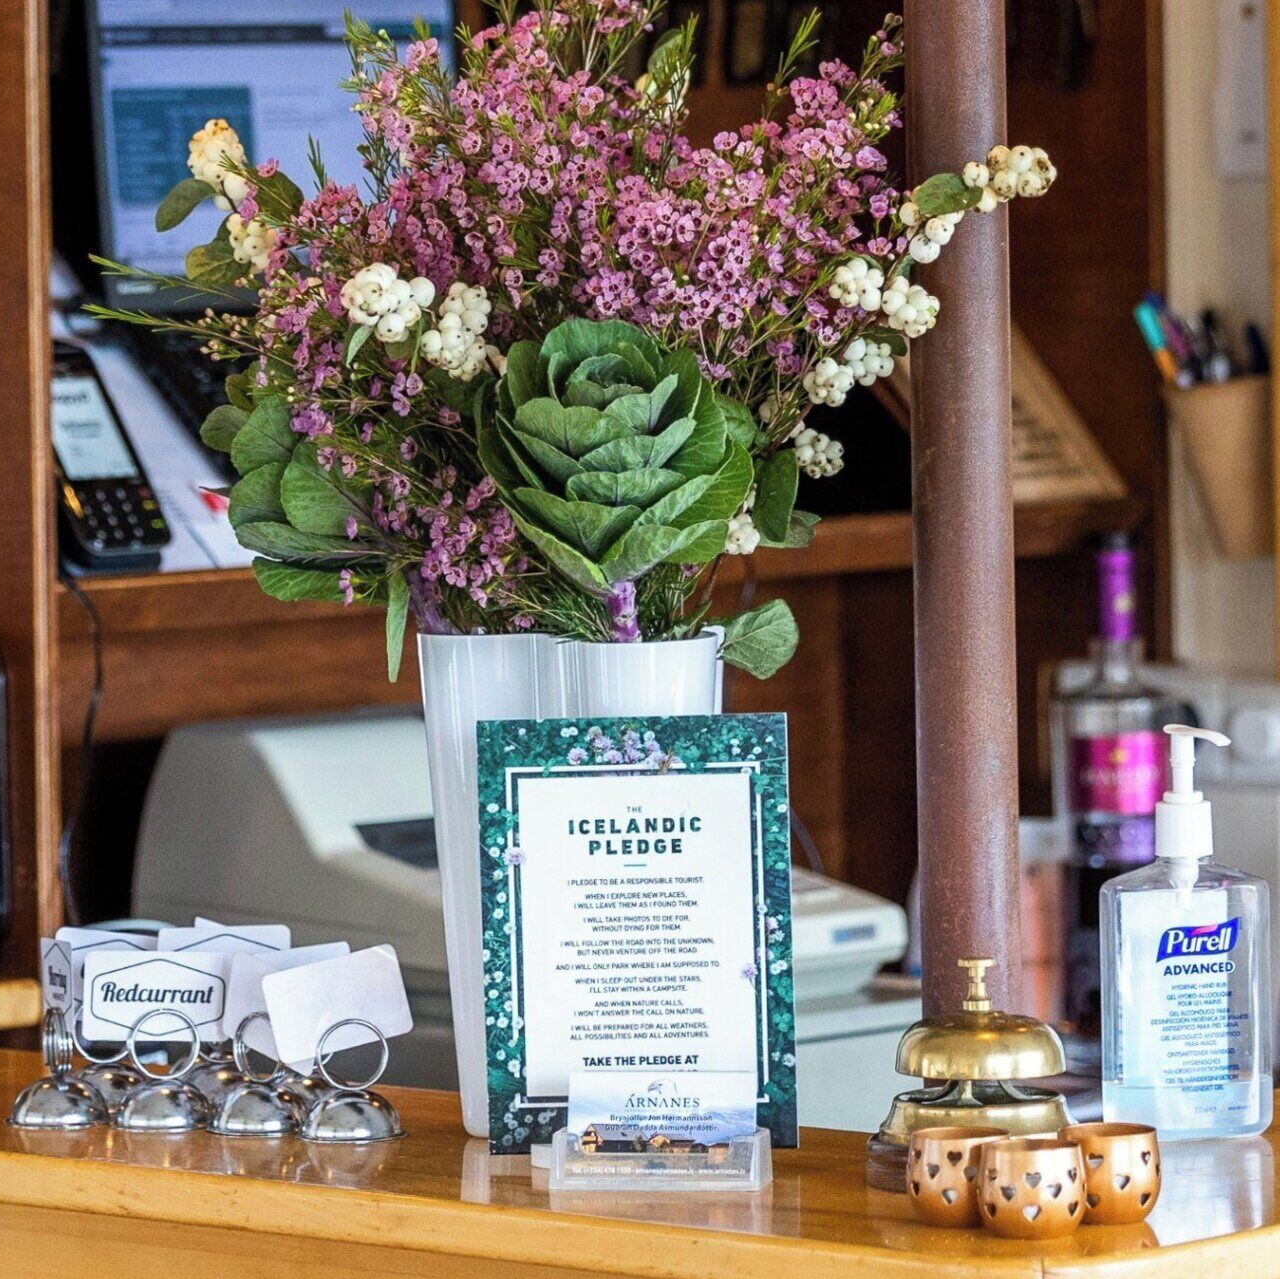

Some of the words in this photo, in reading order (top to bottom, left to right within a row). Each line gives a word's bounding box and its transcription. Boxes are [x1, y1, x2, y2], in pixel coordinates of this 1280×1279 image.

[568, 816, 702, 835] ICELANDIC
[589, 838, 683, 855] PLEDGE
[1167, 927, 1231, 953] Purell
[1164, 962, 1233, 976] ADVANCED
[100, 981, 215, 1006] Redcurrant
[583, 1057, 611, 1066] TAKE
[615, 1057, 635, 1065] THE
[638, 1056, 681, 1065] PLEDGE
[684, 1055, 699, 1064] AT
[625, 1093, 701, 1108] ÁRNANES
